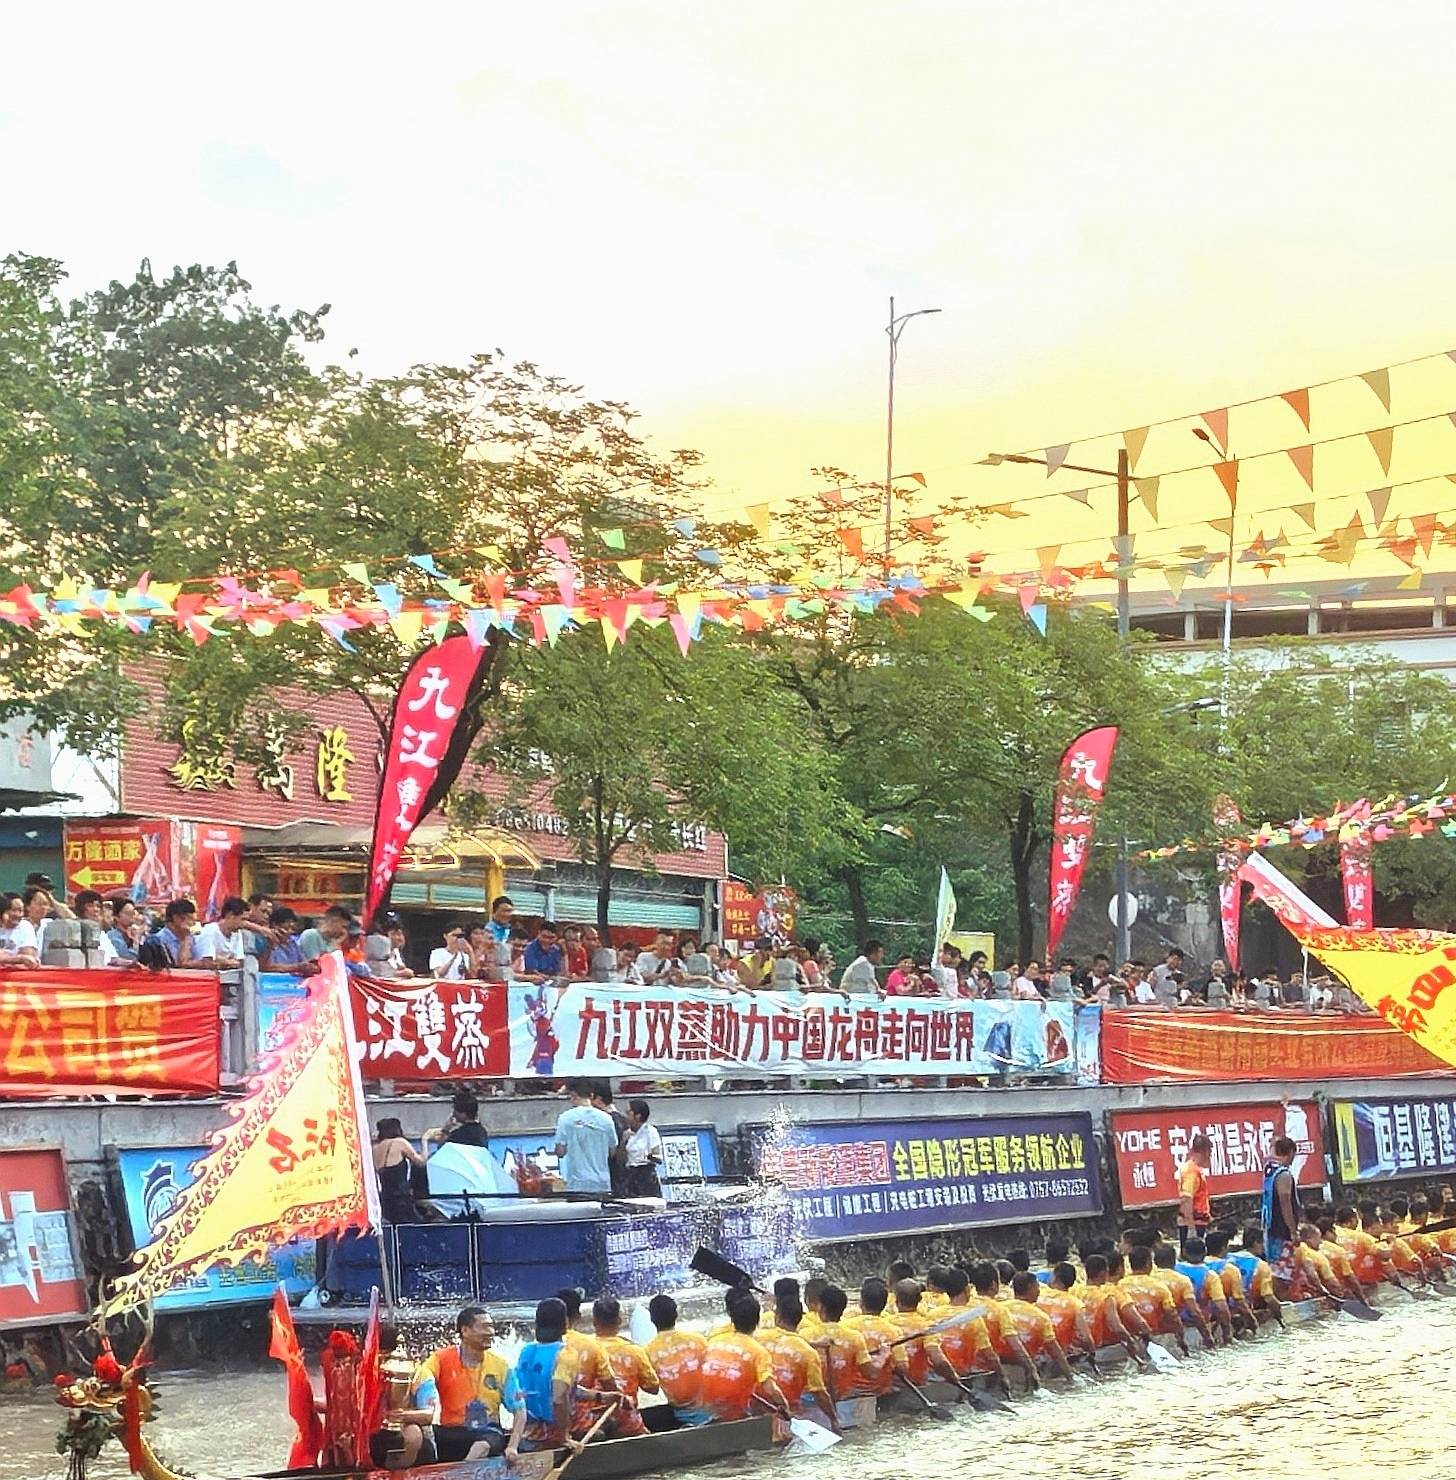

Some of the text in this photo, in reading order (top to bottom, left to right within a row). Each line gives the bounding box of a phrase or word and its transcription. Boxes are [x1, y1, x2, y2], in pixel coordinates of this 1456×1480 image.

[575, 996, 974, 1063] 九江双蒸助力中国龙舟走向世界
